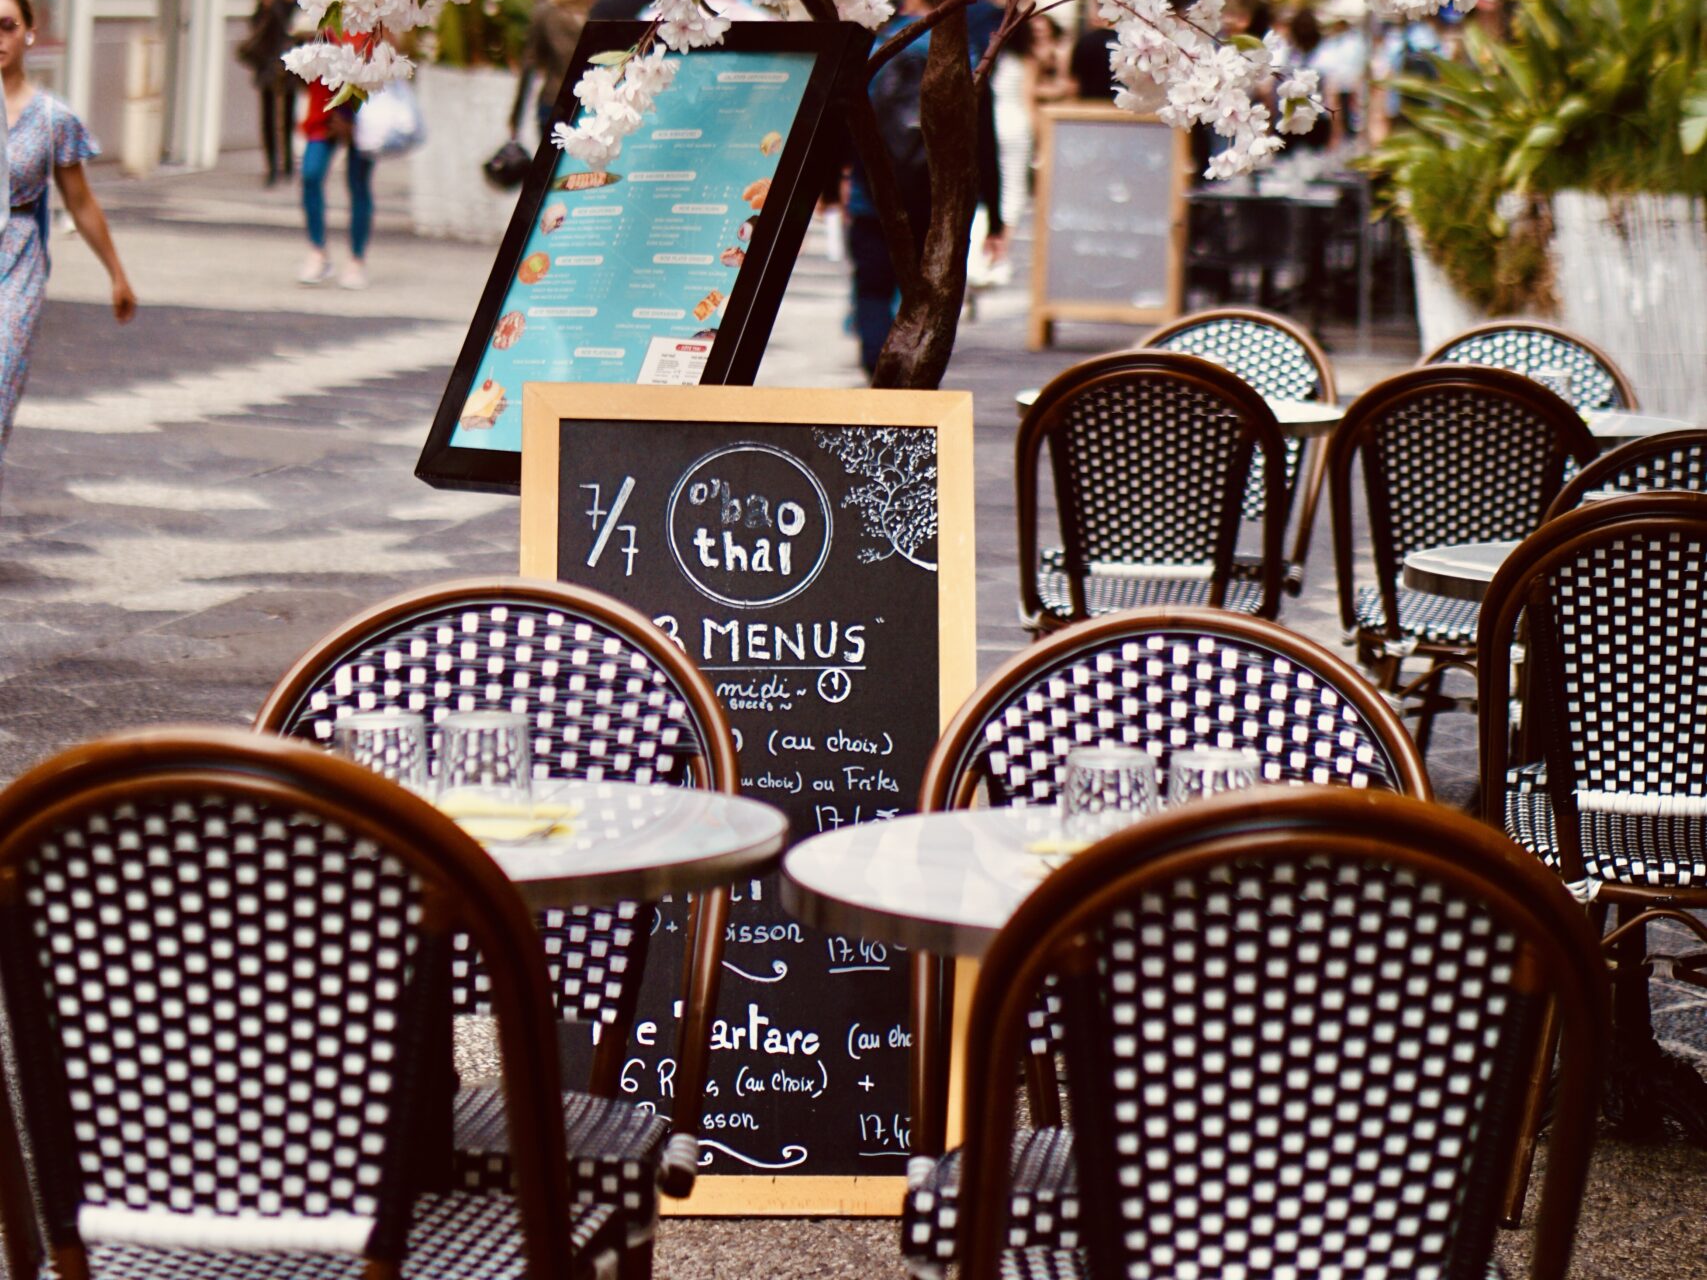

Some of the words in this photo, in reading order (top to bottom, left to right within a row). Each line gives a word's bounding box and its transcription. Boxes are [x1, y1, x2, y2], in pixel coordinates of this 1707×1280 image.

[716, 674, 791, 698] midi
[826, 728, 894, 755] choix)
[812, 775, 835, 792] ou
